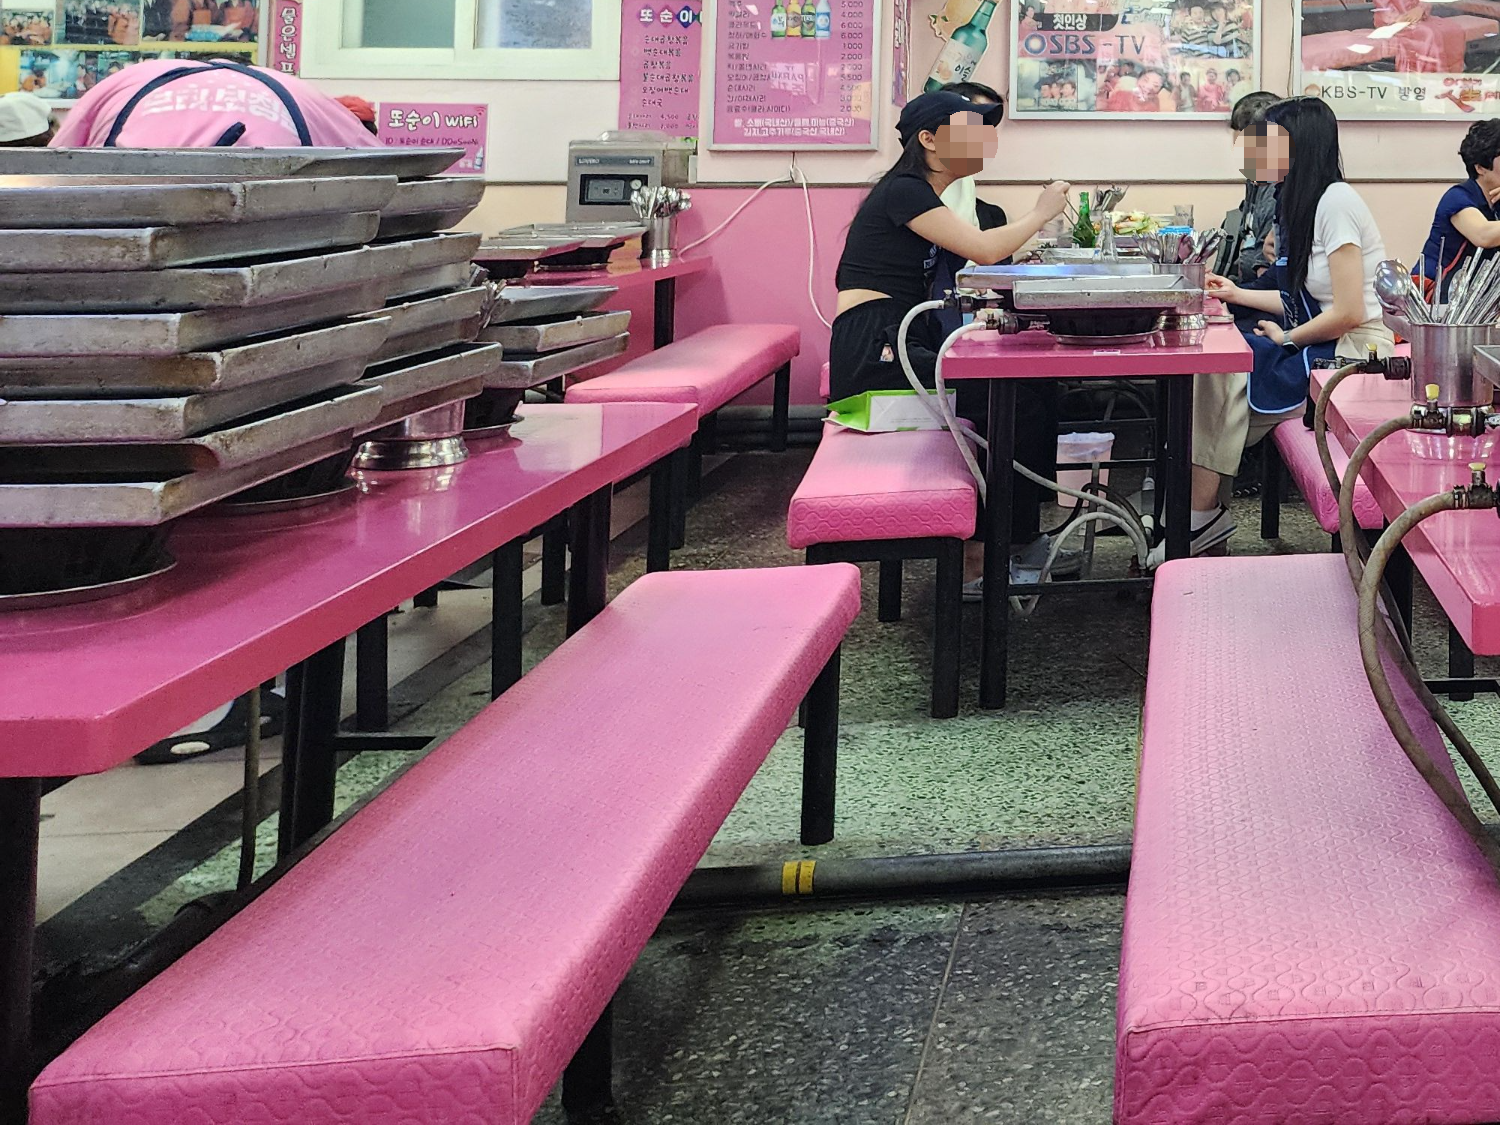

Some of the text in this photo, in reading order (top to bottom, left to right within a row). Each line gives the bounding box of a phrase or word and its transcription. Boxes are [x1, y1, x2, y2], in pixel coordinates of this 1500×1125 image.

[640, 8, 702, 23] 또순이
[1052, 13, 1088, 31] 첫인상
[1050, 34, 1096, 55] SBS
[1321, 85, 1427, 101] KBS-TV 방영
[388, 109, 440, 131] 또순이
